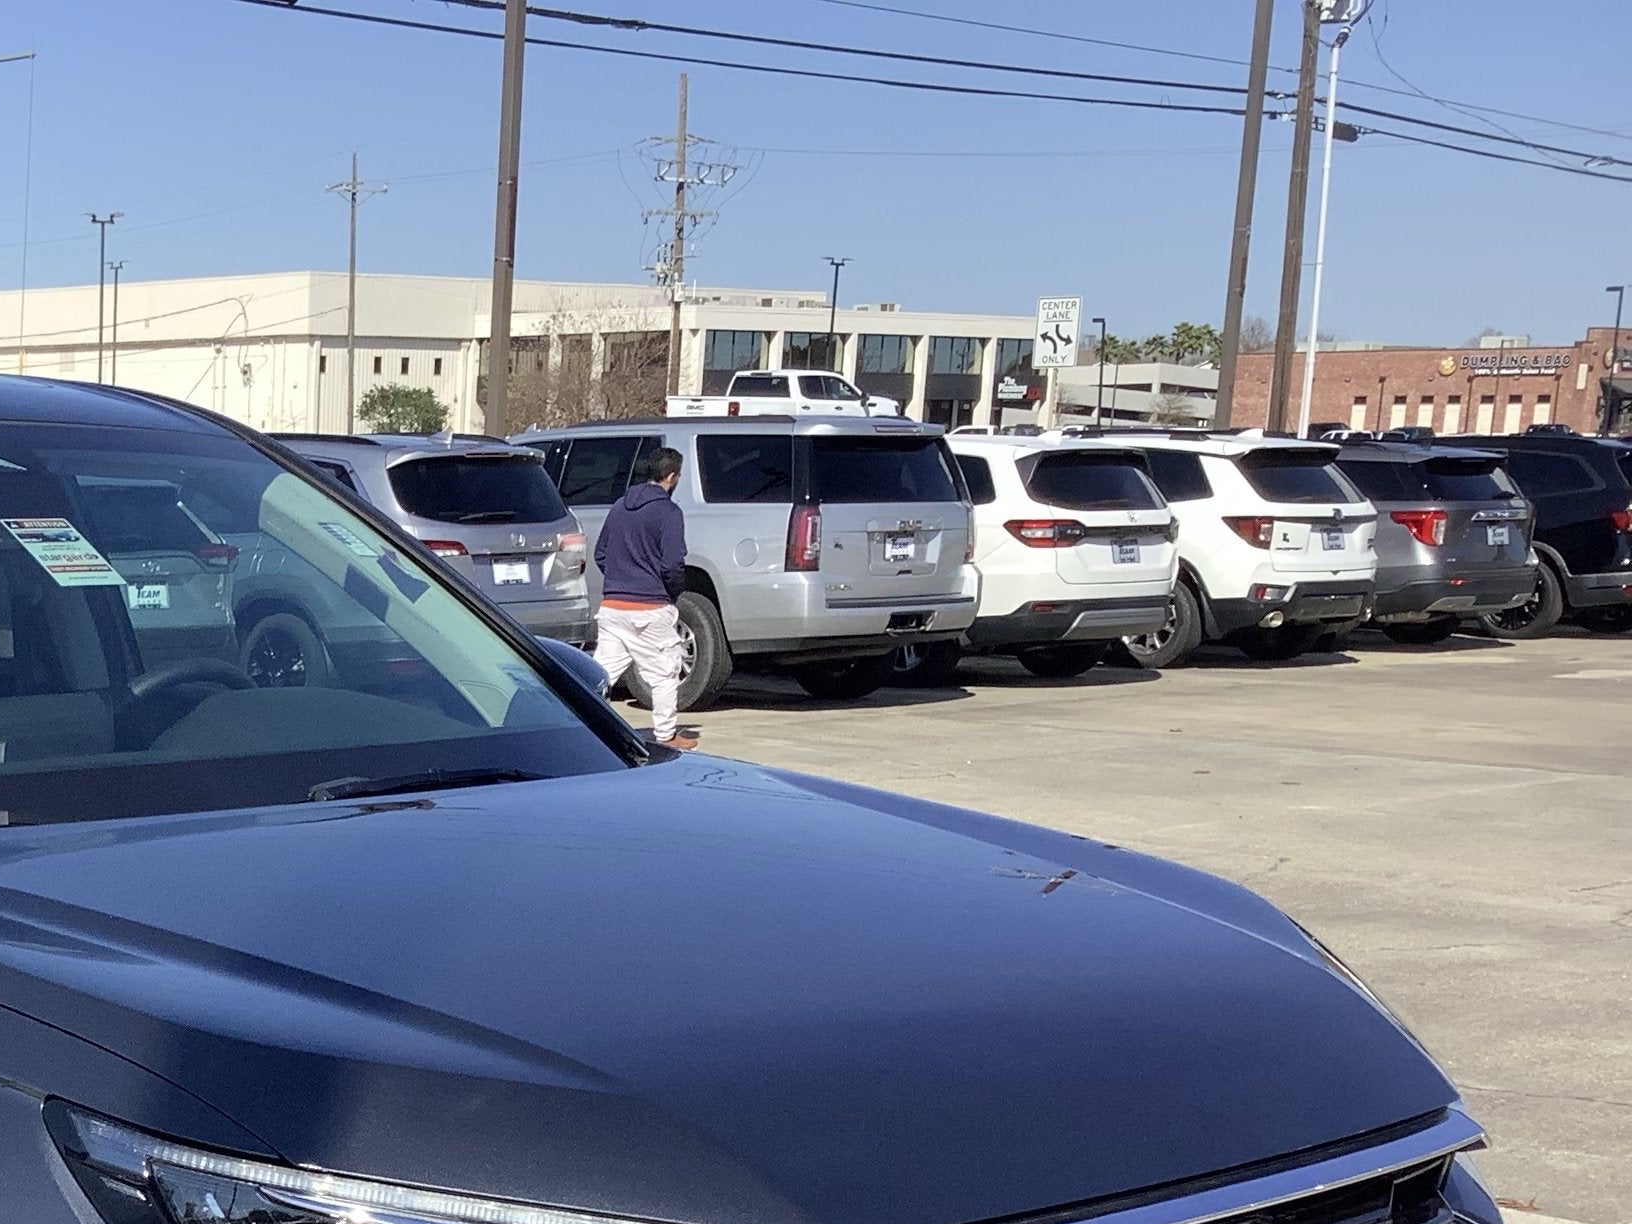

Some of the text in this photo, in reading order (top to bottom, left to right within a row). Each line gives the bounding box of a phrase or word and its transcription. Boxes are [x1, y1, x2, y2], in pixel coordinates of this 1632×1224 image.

[1042, 301, 1077, 310] CENTER
[1046, 311, 1070, 319] LANE
[1042, 355, 1067, 364] ONLY
[1532, 356, 1541, 367] &
[1545, 355, 1571, 367] BAO
[23, 520, 69, 528] ATTENTION
[137, 587, 161, 599] TEAM
